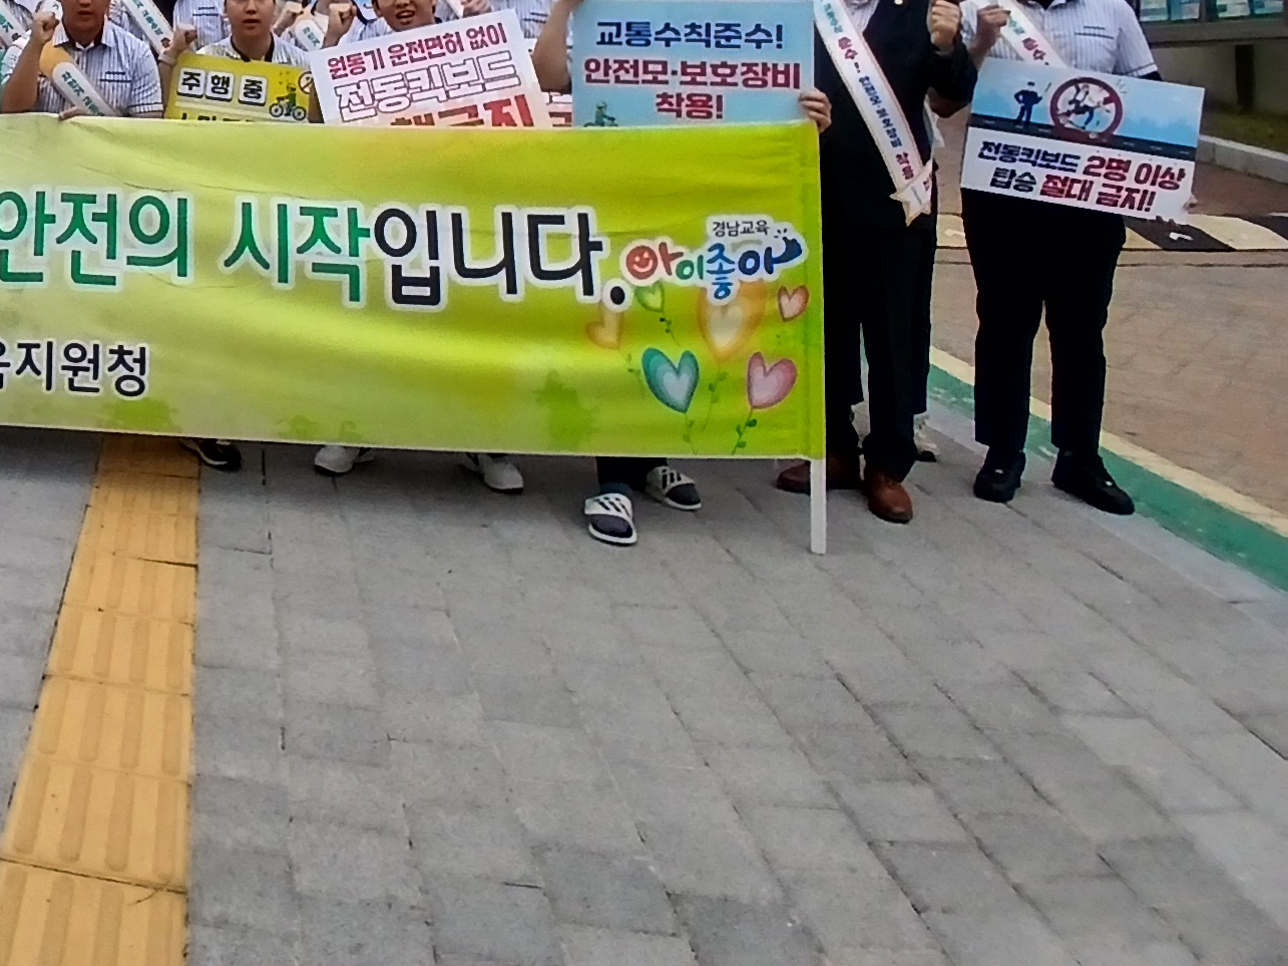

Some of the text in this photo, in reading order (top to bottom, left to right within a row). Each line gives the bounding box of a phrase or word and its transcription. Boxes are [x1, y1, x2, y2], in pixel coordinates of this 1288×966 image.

[327, 22, 508, 81] 원동기 운전면허 없이
[595, 21, 784, 49] 교통수칙준수!
[181, 70, 263, 100] 주행 중
[334, 49, 522, 124] 전동킥보드
[584, 57, 802, 90] 안전모·보호장비
[655, 91, 724, 120] 착용!
[977, 140, 1187, 191] 전동킥보드 2명 이상
[989, 166, 1157, 213] 탑승 절대 금지!
[712, 219, 771, 238] 경남교육
[222, 200, 626, 307] 시작입니다.
[625, 240, 804, 301] 아이좋아
